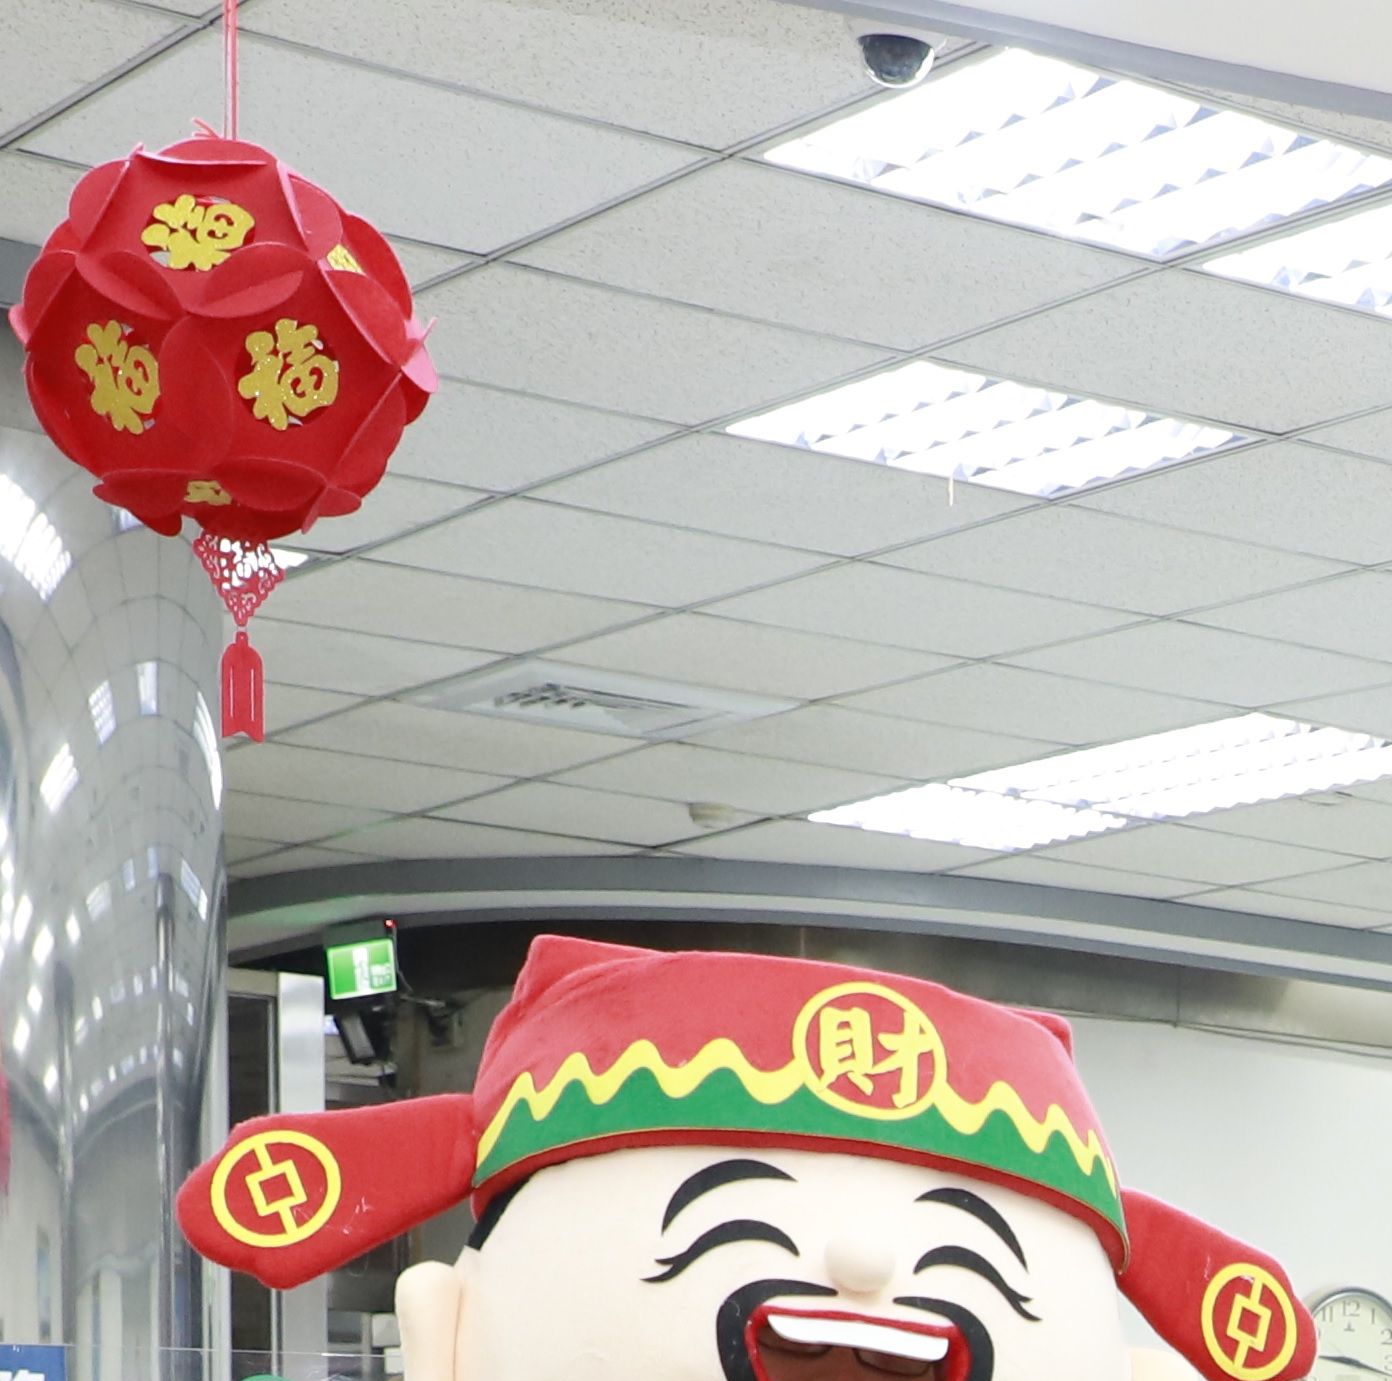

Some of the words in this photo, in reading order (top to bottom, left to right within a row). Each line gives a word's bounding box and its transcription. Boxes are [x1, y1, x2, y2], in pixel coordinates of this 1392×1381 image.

[818, 1006, 935, 1109] 財
[1322, 1306, 1333, 1322] 11
[1342, 1300, 1361, 1317] 12
